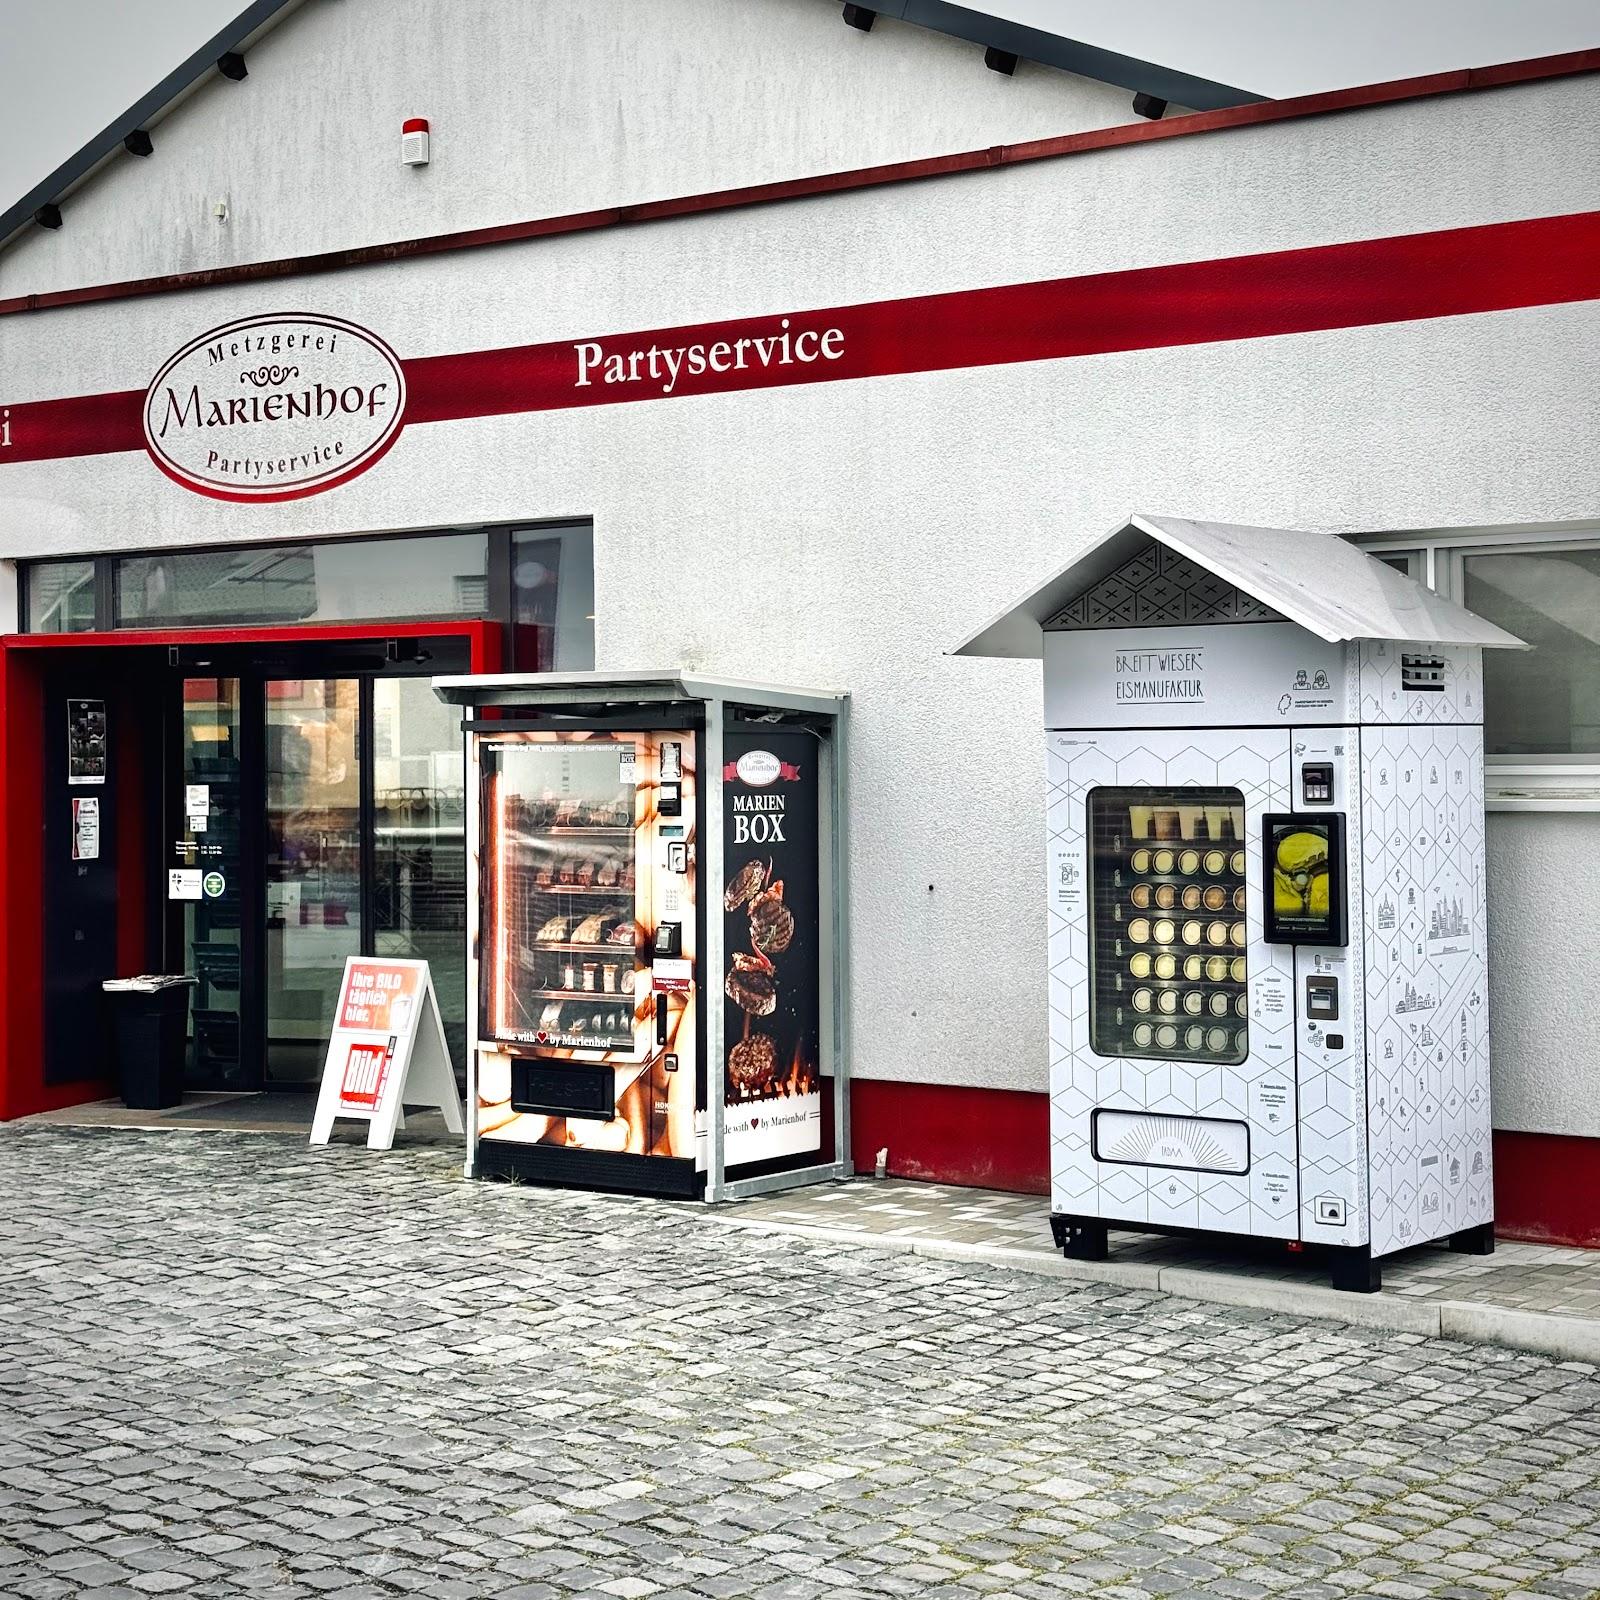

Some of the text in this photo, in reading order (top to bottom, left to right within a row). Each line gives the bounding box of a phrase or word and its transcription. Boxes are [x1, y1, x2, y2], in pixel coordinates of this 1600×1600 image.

[207, 333, 337, 367] Metzgerei
[573, 319, 845, 393] Partyservice
[205, 440, 344, 480] Partyservice
[1116, 680, 1203, 699] EISMANUFAKTUR
[733, 795, 785, 811] MARIEN
[733, 813, 786, 844] BOX
[351, 971, 402, 990] Ihre BILD
[348, 988, 387, 1007] täglich
[518, 1031, 535, 1044] with
[549, 1034, 560, 1048] by
[562, 1034, 612, 1048] Marienhof
[342, 1049, 384, 1095] Bild
[733, 1120, 749, 1134] with
[761, 1117, 769, 1130] by
[771, 1110, 807, 1127] Marienhof
